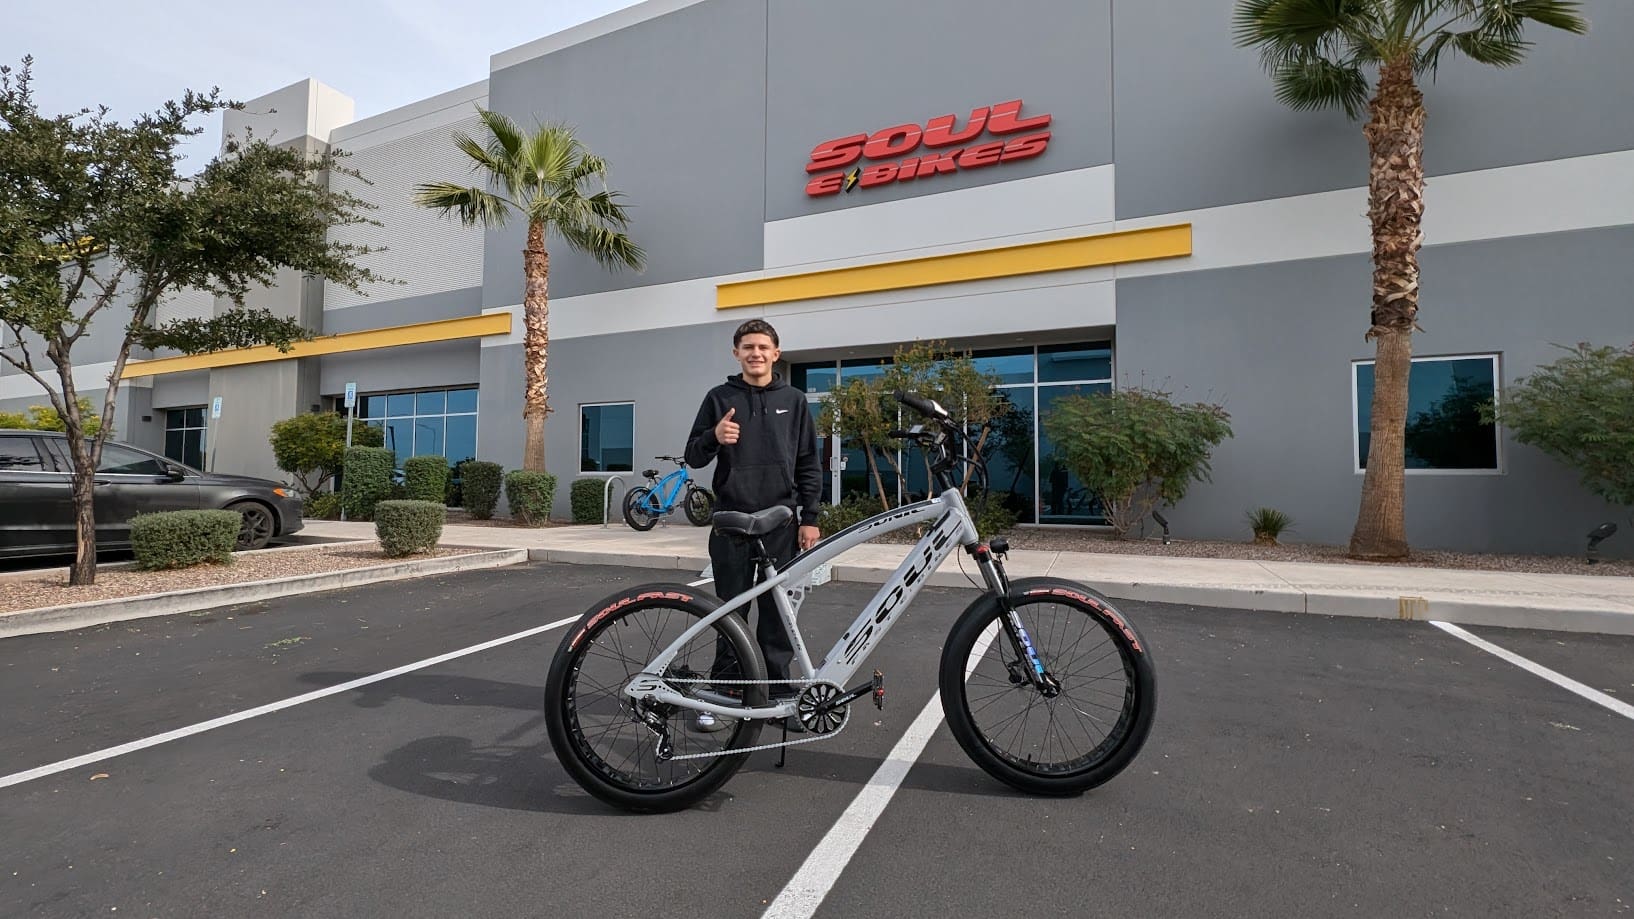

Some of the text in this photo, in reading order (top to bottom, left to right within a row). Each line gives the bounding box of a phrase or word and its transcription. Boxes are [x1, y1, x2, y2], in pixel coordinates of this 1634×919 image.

[806, 99, 1051, 174] SOUL
[859, 131, 1051, 189] BIKES
[843, 519, 962, 665] SOUL
